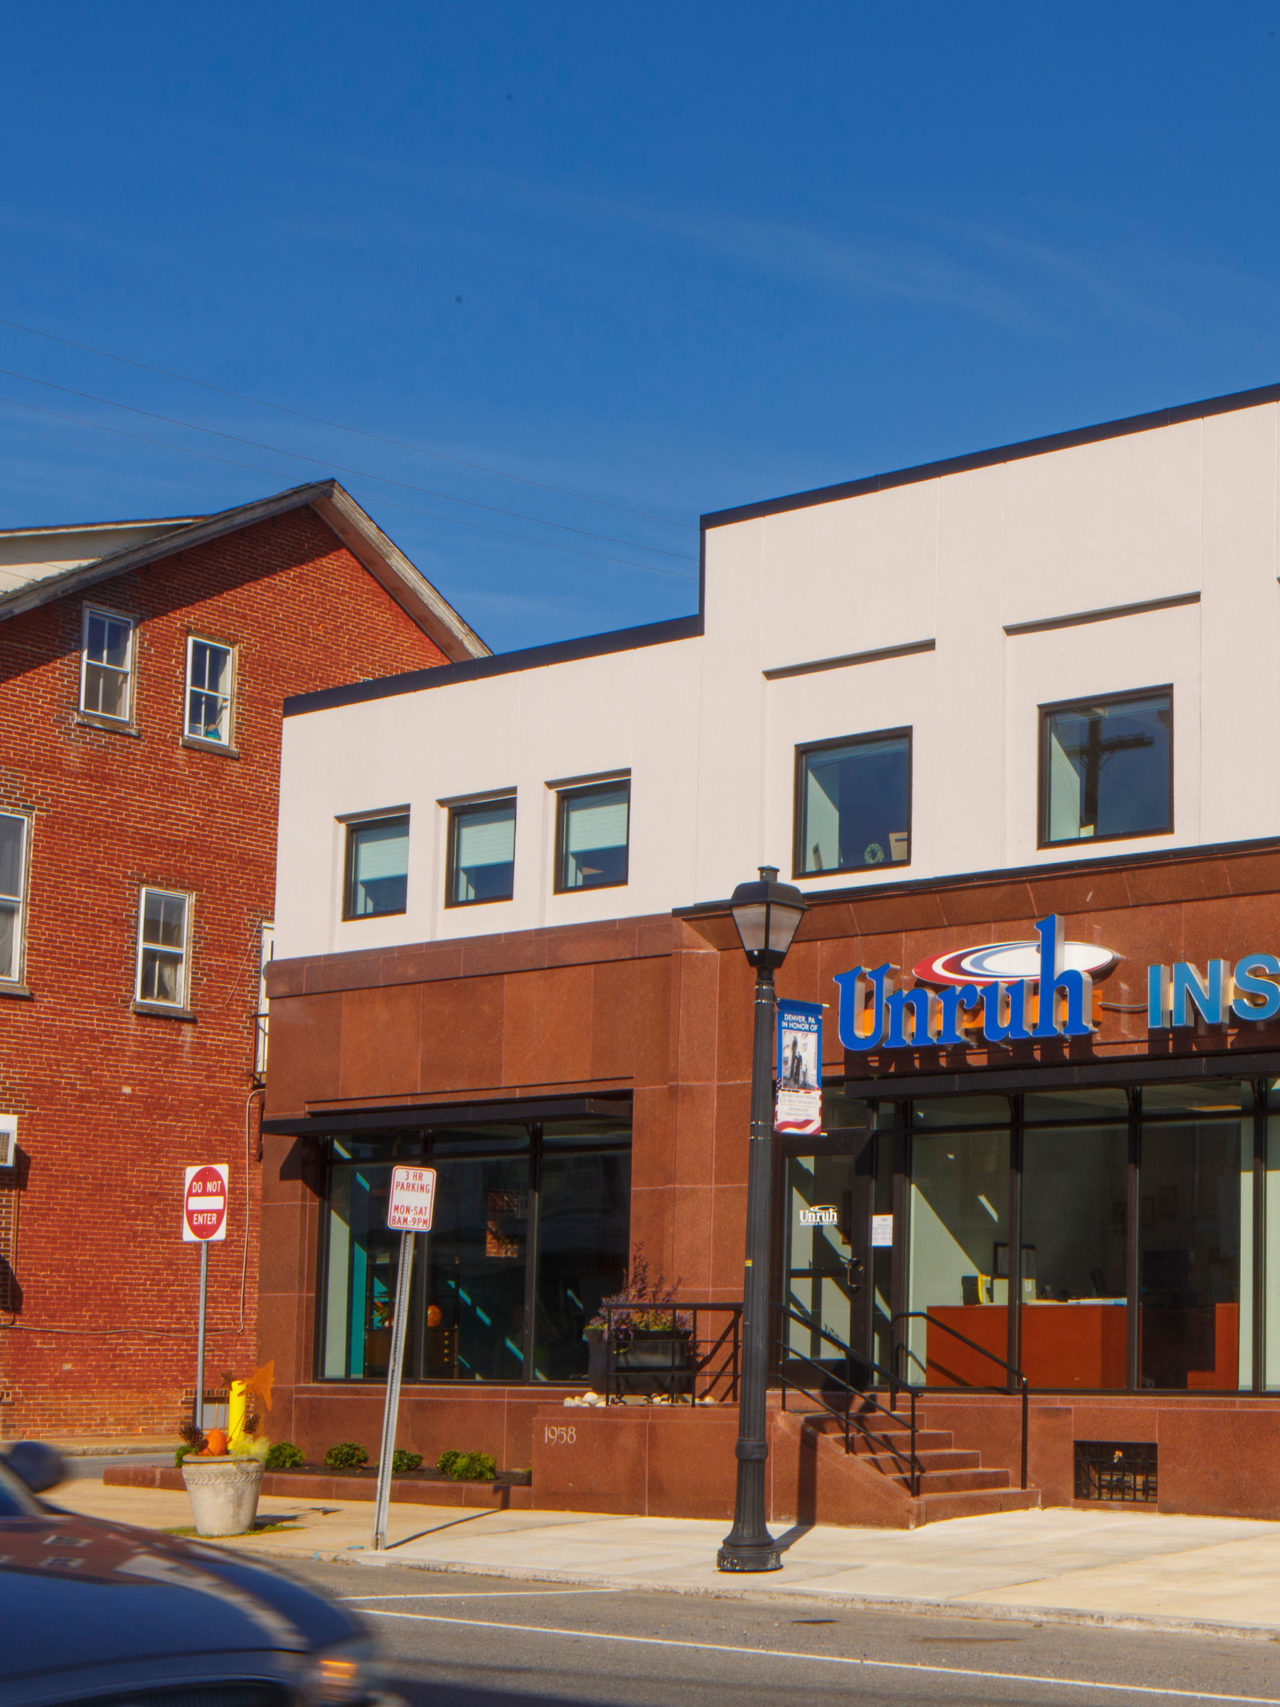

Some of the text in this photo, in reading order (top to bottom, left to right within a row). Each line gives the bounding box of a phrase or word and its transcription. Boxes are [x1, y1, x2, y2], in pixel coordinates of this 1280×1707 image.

[833, 913, 1096, 1050] Unruh
[782, 1020, 818, 1032] IN HONOR OF
[404, 1171, 424, 1182] 3 HR
[192, 1180, 222, 1193] DO NOT
[395, 1181, 431, 1194] PARKING
[393, 1204, 428, 1217] MON-SAT
[799, 1207, 838, 1224] Unruh
[193, 1212, 217, 1225] ENTER
[391, 1215, 428, 1228] 8AM-9PM
[544, 1424, 577, 1447] 1958
